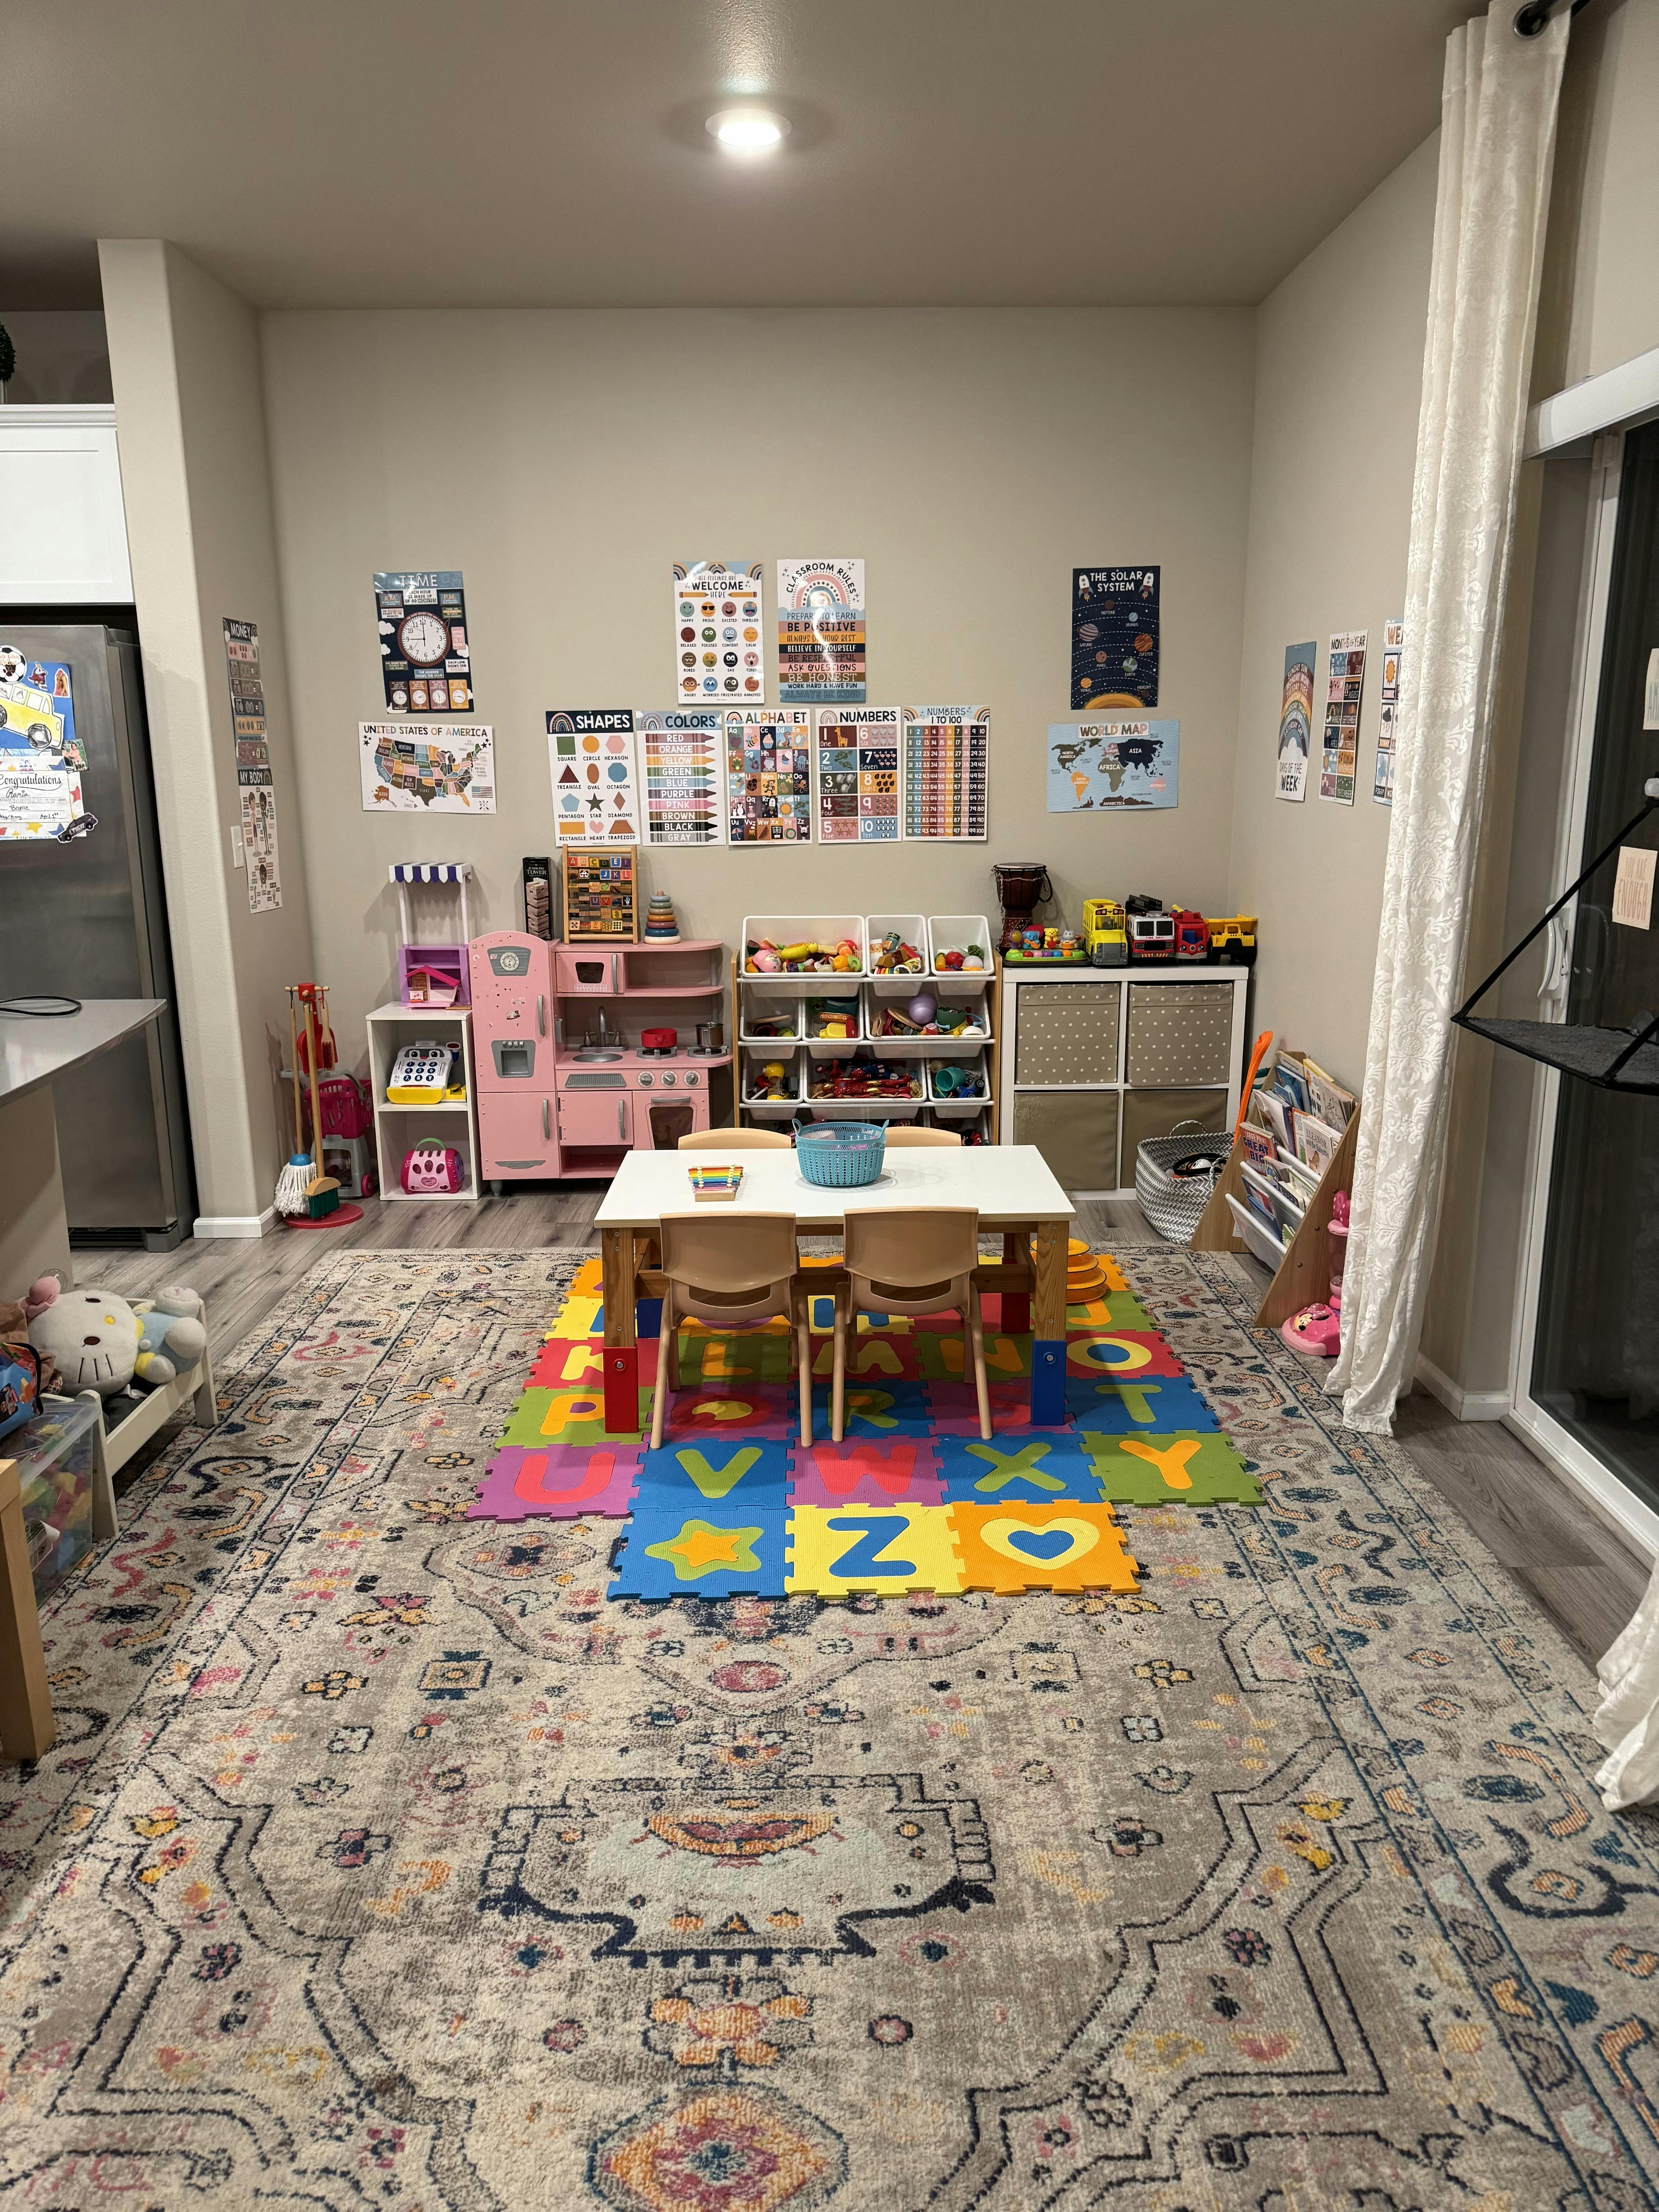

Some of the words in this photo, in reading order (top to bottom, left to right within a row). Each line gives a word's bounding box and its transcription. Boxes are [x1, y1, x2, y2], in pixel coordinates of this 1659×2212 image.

[399, 575, 438, 587] TIME
[787, 563, 834, 593] CLASSROOM
[837, 568, 856, 594] RULES
[1090, 573, 1107, 582] THE
[1111, 571, 1142, 581] SOLAR
[692, 582, 744, 590] WELCOME
[1097, 582, 1134, 592] SYSTEM
[230, 622, 250, 639] MONEY
[788, 622, 799, 632] BE
[1331, 637, 1349, 650] MONTHS
[1355, 635, 1365, 647] YEAR
[808, 664, 856, 672] QUESTIONS
[788, 673, 803, 682] BE
[809, 673, 857, 682] HONEST
[785, 690, 821, 699] ALWAYS
[836, 690, 860, 698] KIND
[745, 712, 807, 724] ALPHABET
[840, 711, 896, 723] NUMBERS
[927, 708, 965, 716] NUMBERS
[576, 715, 630, 728] SHAPES
[665, 716, 716, 728] COLORS
[364, 725, 396, 734] UNITED
[400, 726, 428, 735] STATES
[431, 727, 442, 735] OF
[447, 728, 488, 737] AMERICA
[860, 727, 868, 740] 6
[1080, 725, 1118, 737] WORLD
[1121, 724, 1147, 735] MAP
[1284, 721, 1298, 738] SATURDAY
[822, 752, 830, 765] 2
[865, 751, 872, 764] 7
[1288, 763, 1293, 773] OF
[1294, 763, 1302, 774] THE
[240, 771, 247, 784] MY
[249, 771, 263, 784] BODY
[825, 775, 833, 788] 3
[864, 773, 872, 786] 8
[1281, 775, 1298, 792] WEEK
[823, 798, 832, 810] 4
[863, 797, 871, 809] 9
[1245, 1131, 1256, 1140] LARGE
[1306, 1129, 1327, 1149] ELEANOR
[1243, 1136, 1269, 1155] GREAT
[1250, 1150, 1265, 1164] BIG
[701, 1342, 753, 1376] L
[1066, 1337, 1152, 1371] O
[827, 1388, 900, 1428] R
[1094, 1384, 1163, 1424] T
[539, 1394, 605, 1436] P
[512, 1451, 616, 1505] U
[674, 1446, 764, 1499] V
[811, 1444, 918, 1496] W
[966, 1441, 1067, 1493] X
[1118, 1439, 1202, 1489] Y
[826, 1515, 918, 1578] Z
